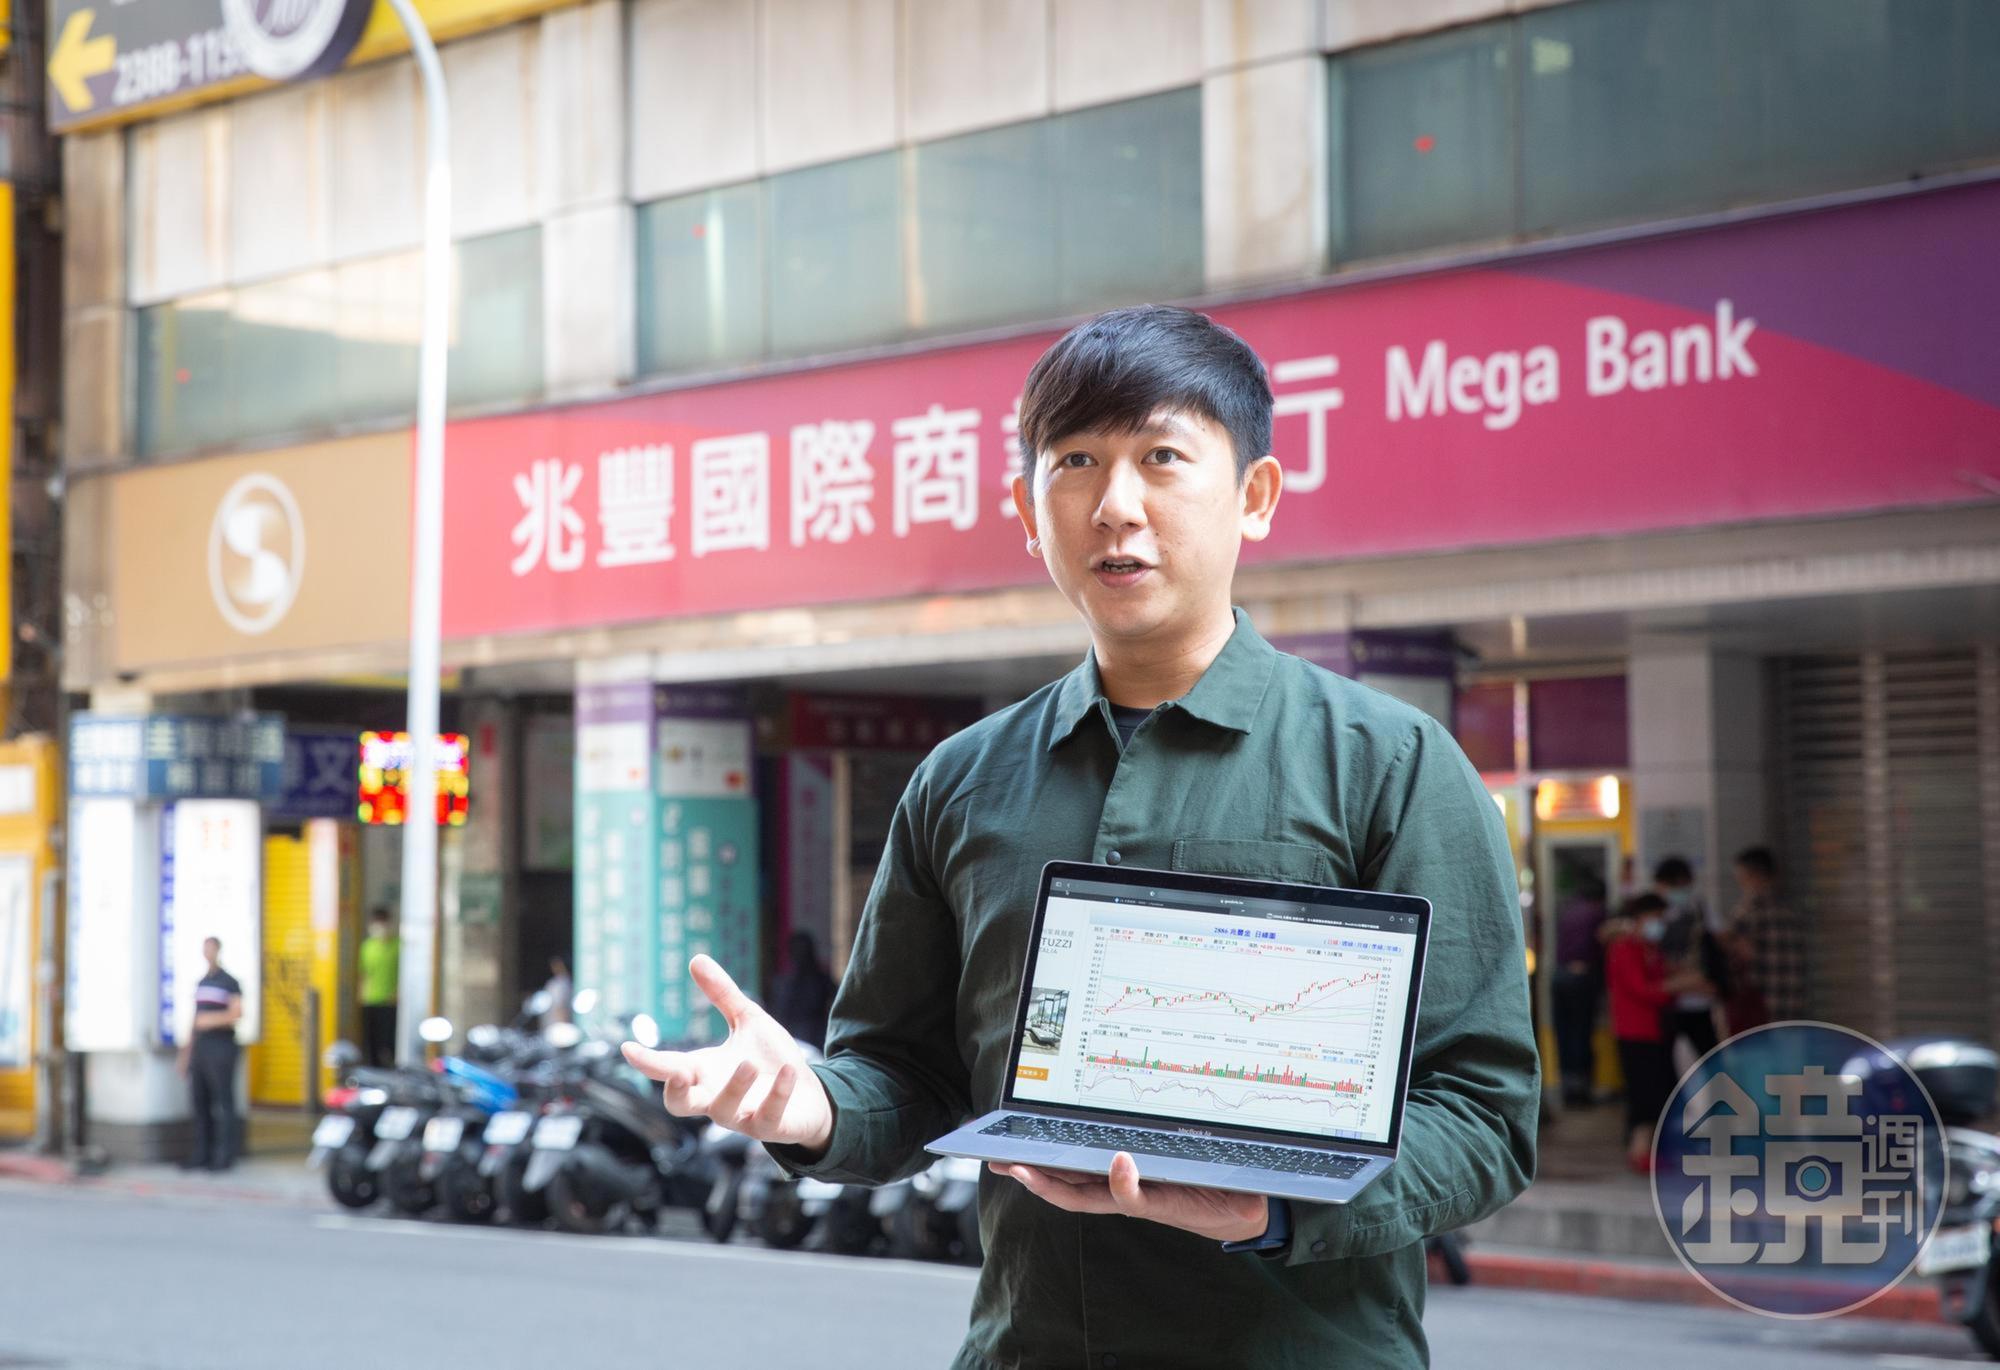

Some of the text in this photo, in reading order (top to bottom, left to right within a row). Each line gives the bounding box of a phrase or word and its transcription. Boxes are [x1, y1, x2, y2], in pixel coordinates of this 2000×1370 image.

[1384, 298, 1758, 431] Mega Bank
[1041, 937, 1072, 948] TUZZI
[1178, 1127, 1203, 1136] MacBook
